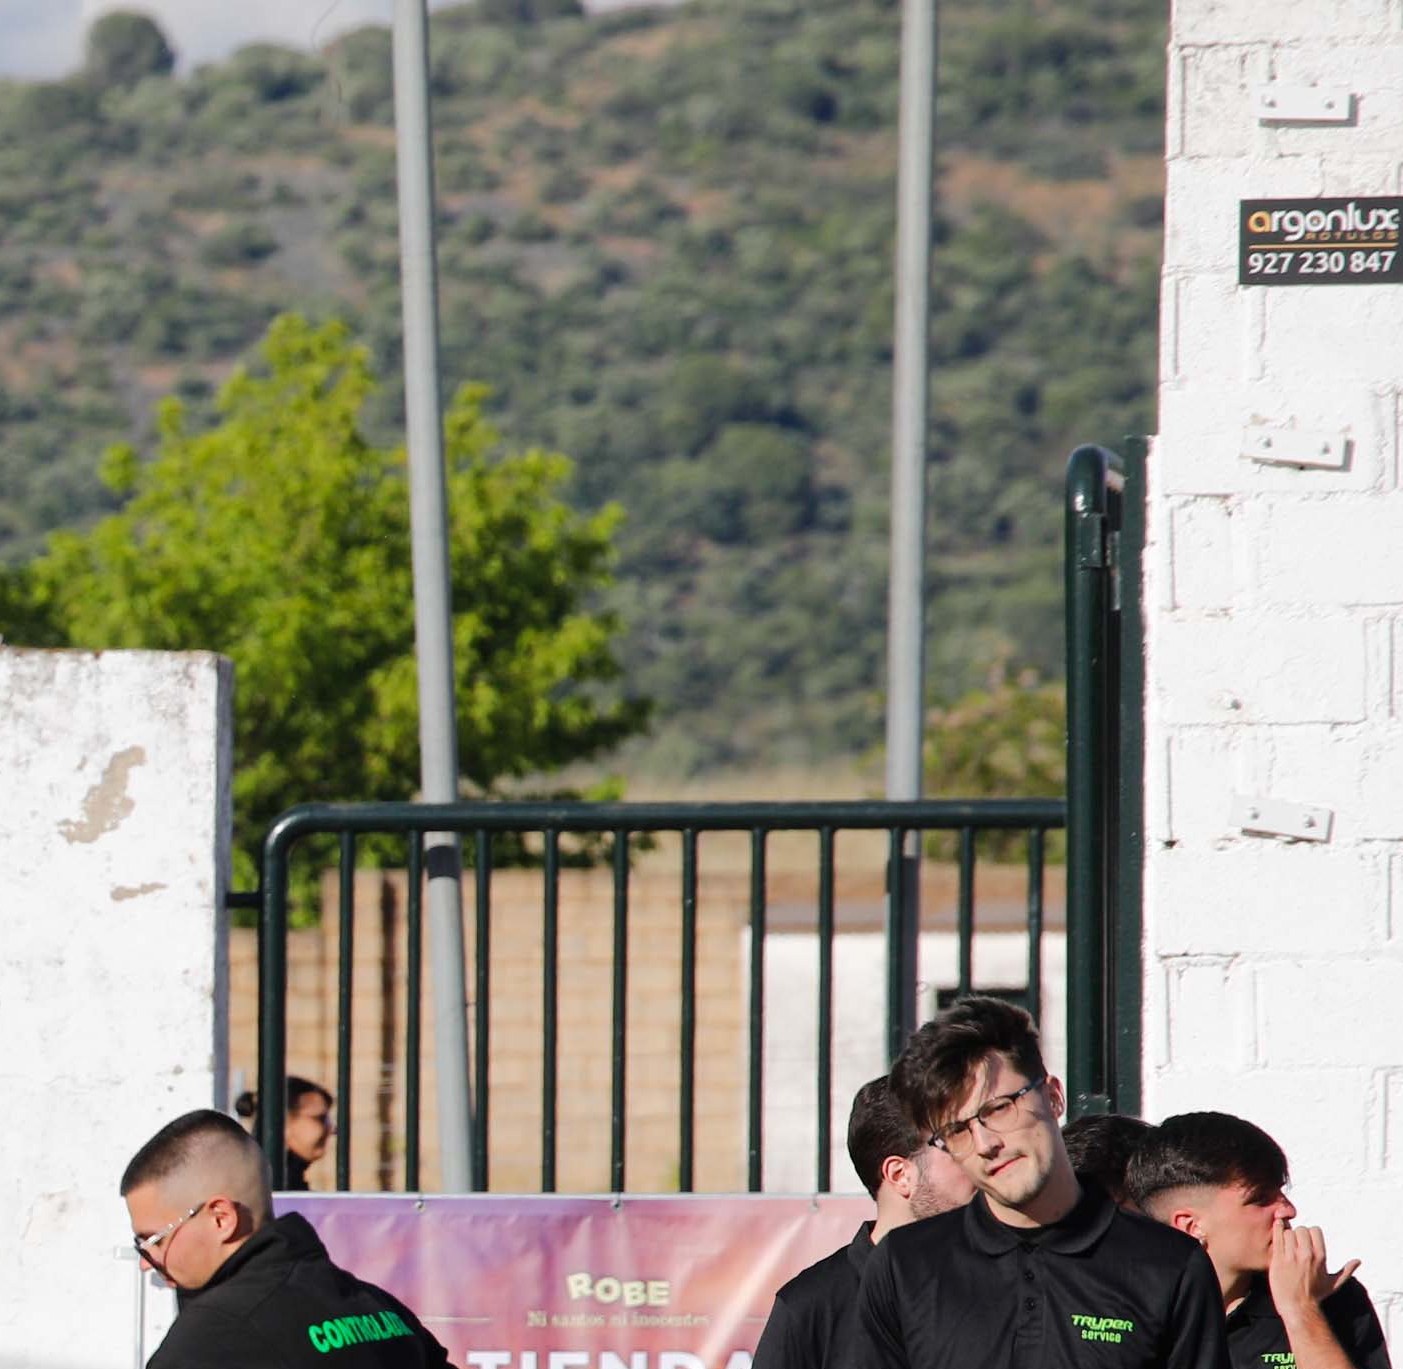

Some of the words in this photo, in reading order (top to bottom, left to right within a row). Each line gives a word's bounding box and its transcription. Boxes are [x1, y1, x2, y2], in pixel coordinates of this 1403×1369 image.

[1248, 202, 1400, 241] argonlux
[1248, 252, 1294, 274] 927
[1298, 251, 1345, 273] 230
[1349, 251, 1396, 273] 847
[566, 1272, 670, 1307] ROBE
